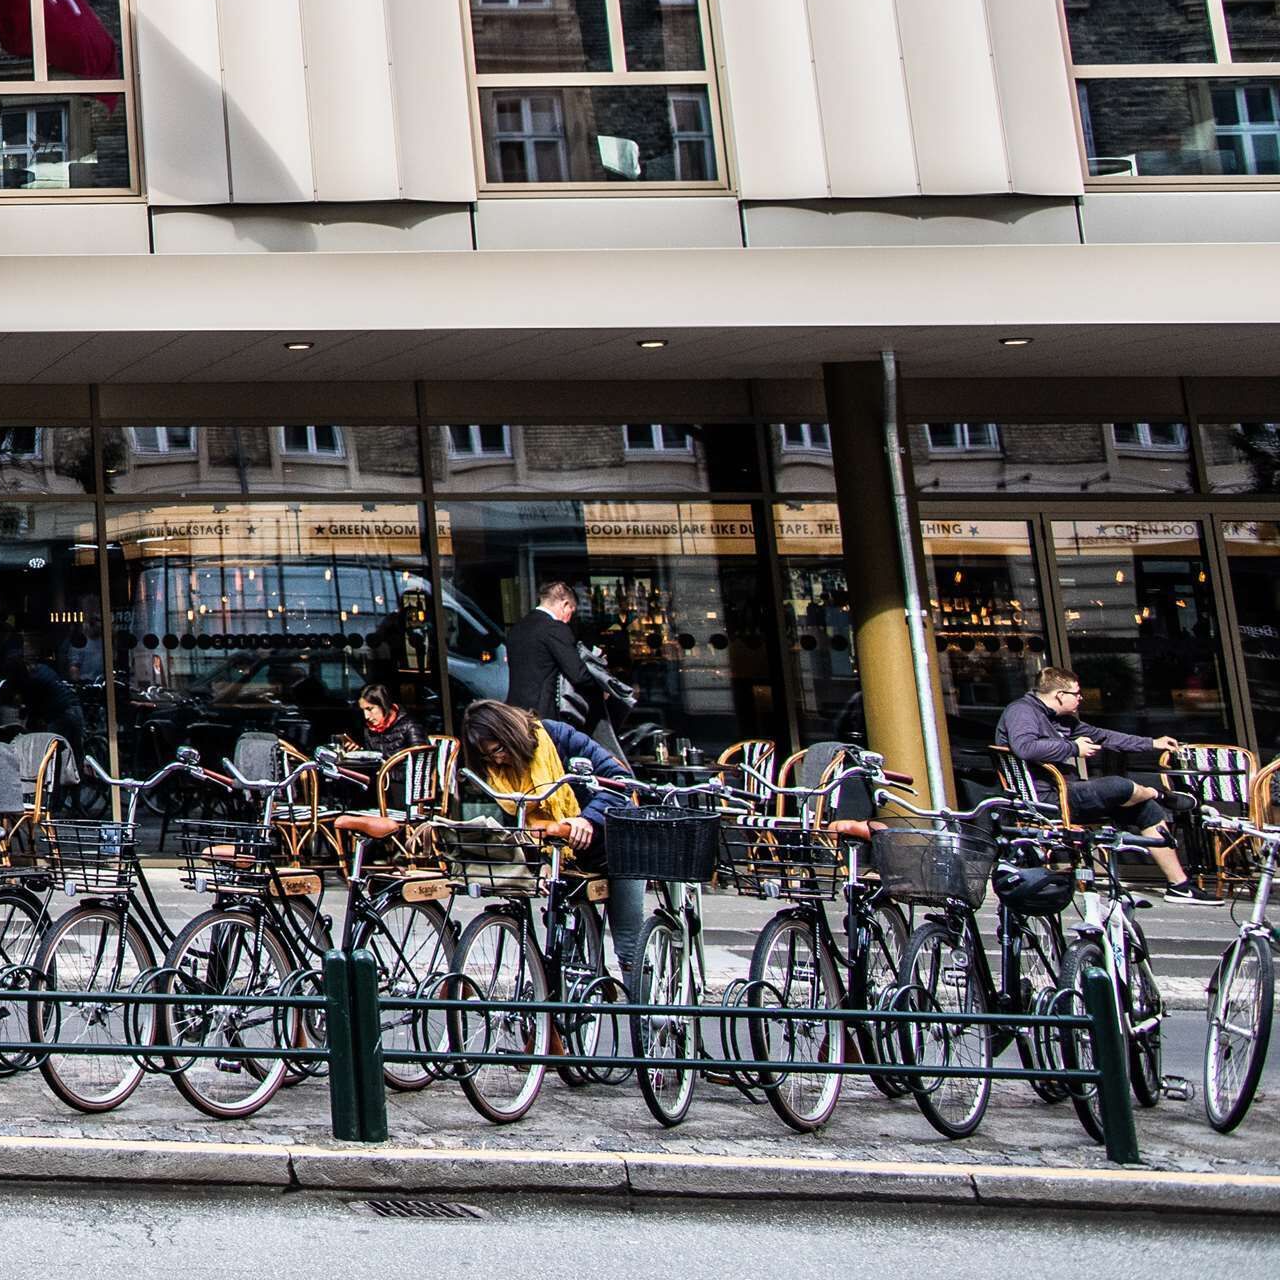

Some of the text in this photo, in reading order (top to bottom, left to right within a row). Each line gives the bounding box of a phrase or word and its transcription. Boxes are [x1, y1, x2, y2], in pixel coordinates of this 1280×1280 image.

[329, 525, 417, 537] GREEN ROOM
[626, 524, 678, 535] FRIENDS
[682, 524, 706, 534] ARE
[710, 524, 736, 534] LIKE
[1164, 523, 1196, 535] ROO
